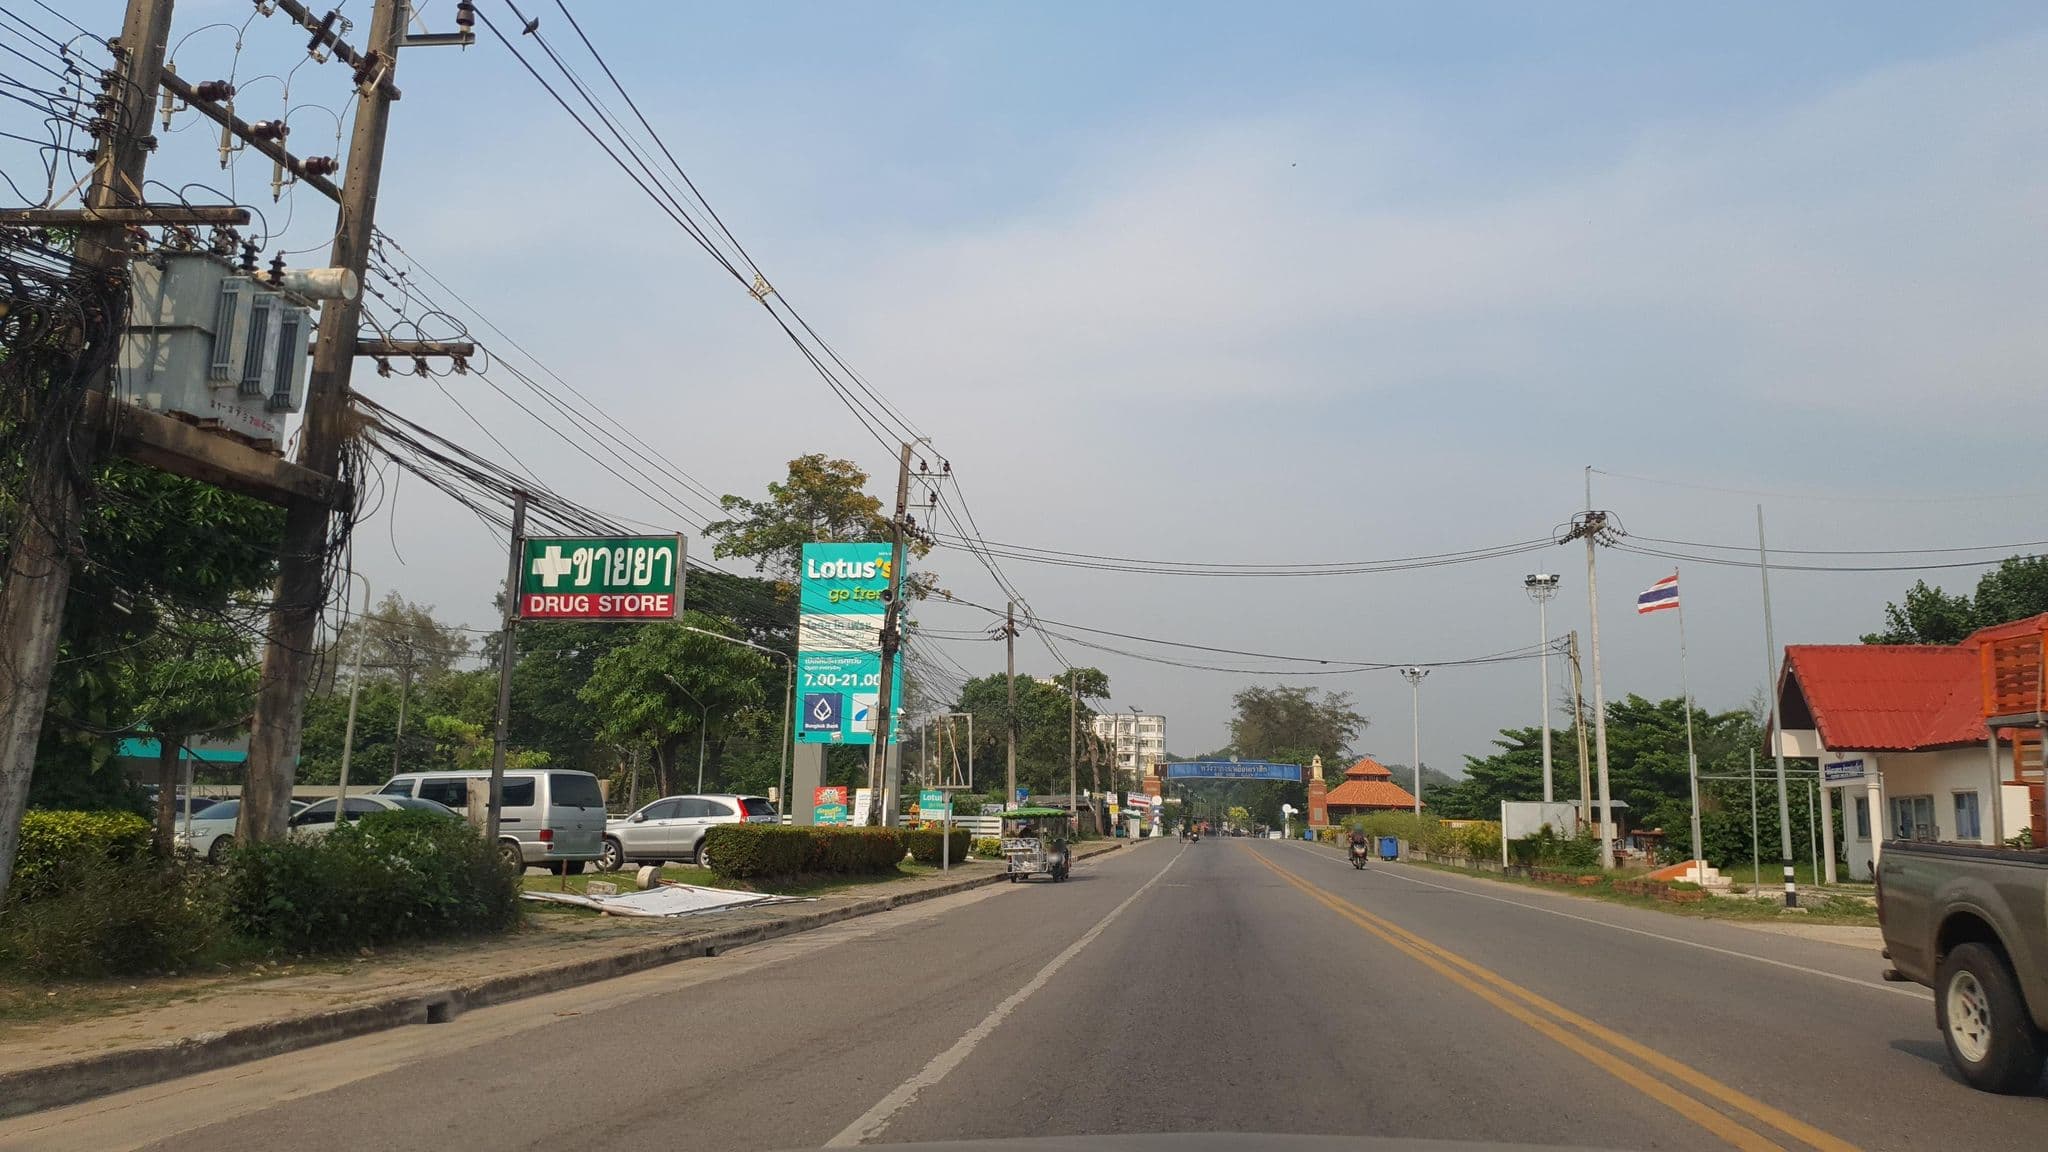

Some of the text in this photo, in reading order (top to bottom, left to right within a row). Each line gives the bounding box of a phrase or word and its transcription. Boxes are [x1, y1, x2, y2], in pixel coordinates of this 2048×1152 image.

[573, 546, 673, 586] ขายยา
[530, 595, 669, 612] DRUG STORE
[829, 589, 850, 603] go
[804, 673, 882, 687] 7.00-21.00
